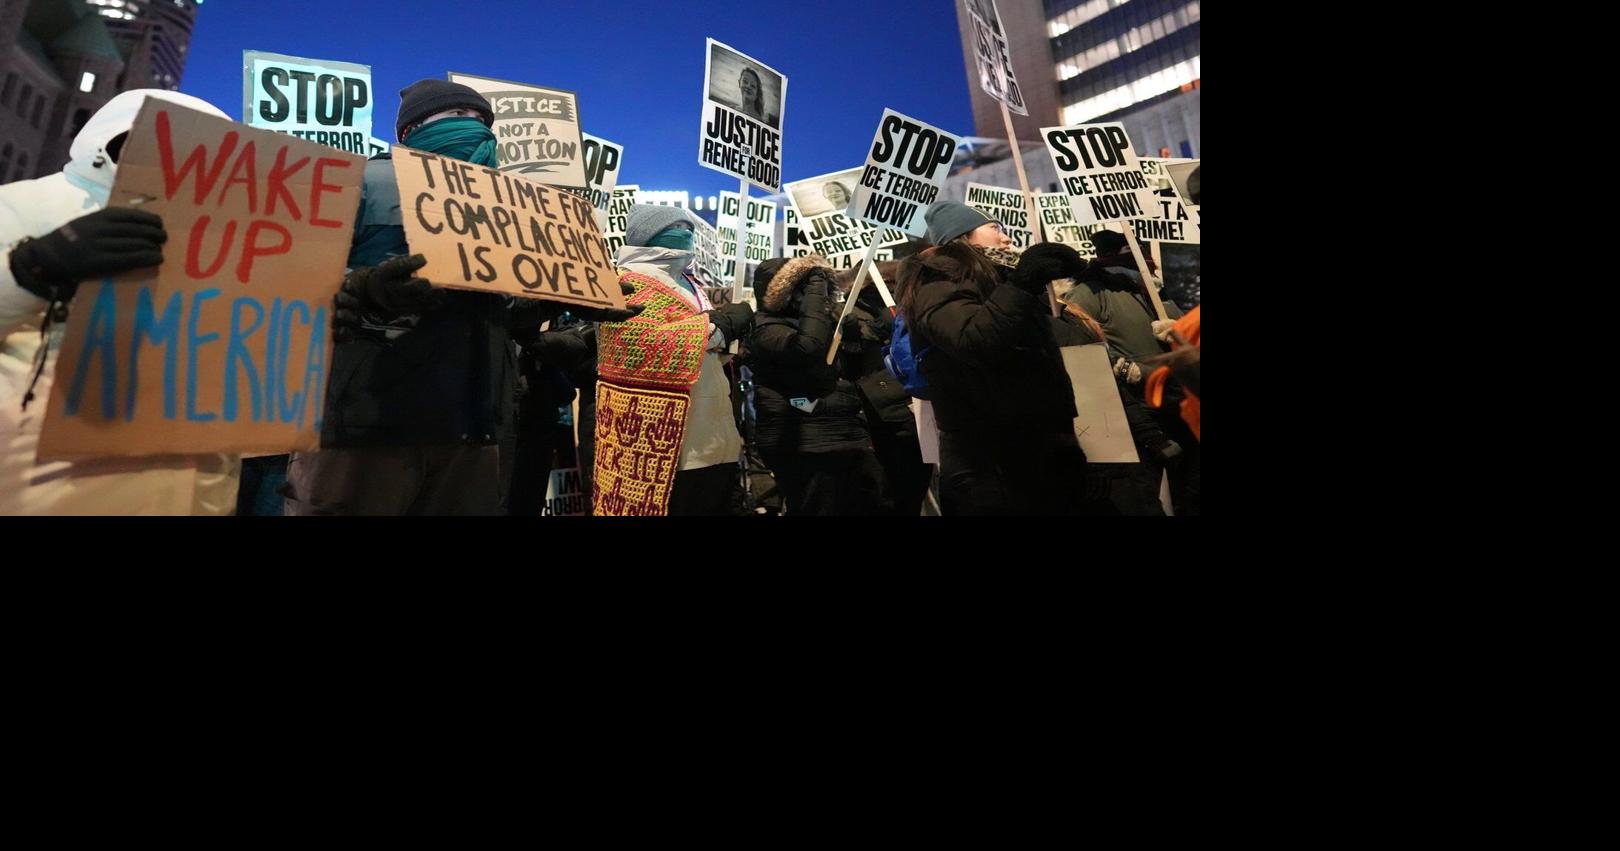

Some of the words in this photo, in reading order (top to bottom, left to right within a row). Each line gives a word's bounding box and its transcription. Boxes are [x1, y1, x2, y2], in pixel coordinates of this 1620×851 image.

[259, 66, 367, 126] STOP
[491, 97, 562, 115] STICE
[498, 123, 534, 138] NOT
[537, 123, 550, 137] A
[707, 106, 779, 164] JUSTICE
[872, 115, 955, 179] STOP
[1047, 126, 1128, 172] STOP
[155, 111, 351, 229] WAKE
[497, 139, 577, 166] MOTION
[584, 139, 618, 185] OP
[703, 138, 745, 176] RENEE
[748, 156, 779, 189] GOOD
[1140, 160, 1167, 175] EST
[410, 151, 481, 198] THE
[483, 168, 557, 219] TIME
[560, 193, 600, 233] FOR
[860, 164, 886, 190] ICE
[885, 172, 938, 205] TERROR
[968, 187, 1027, 210] MINNESOT
[1063, 176, 1092, 196] ICE
[1090, 170, 1148, 193] TERROR
[746, 201, 773, 223] OUT
[864, 192, 918, 229] NOW!
[1089, 192, 1144, 220] NOW!
[1177, 202, 1188, 220] A
[185, 217, 292, 283] UP
[415, 192, 612, 271] COMPLACENCY
[813, 236, 861, 256] RENEE
[458, 243, 497, 282] IS
[512, 254, 608, 298] OVER
[64, 278, 328, 433] AMERICA
[629, 450, 671, 484] ICE
